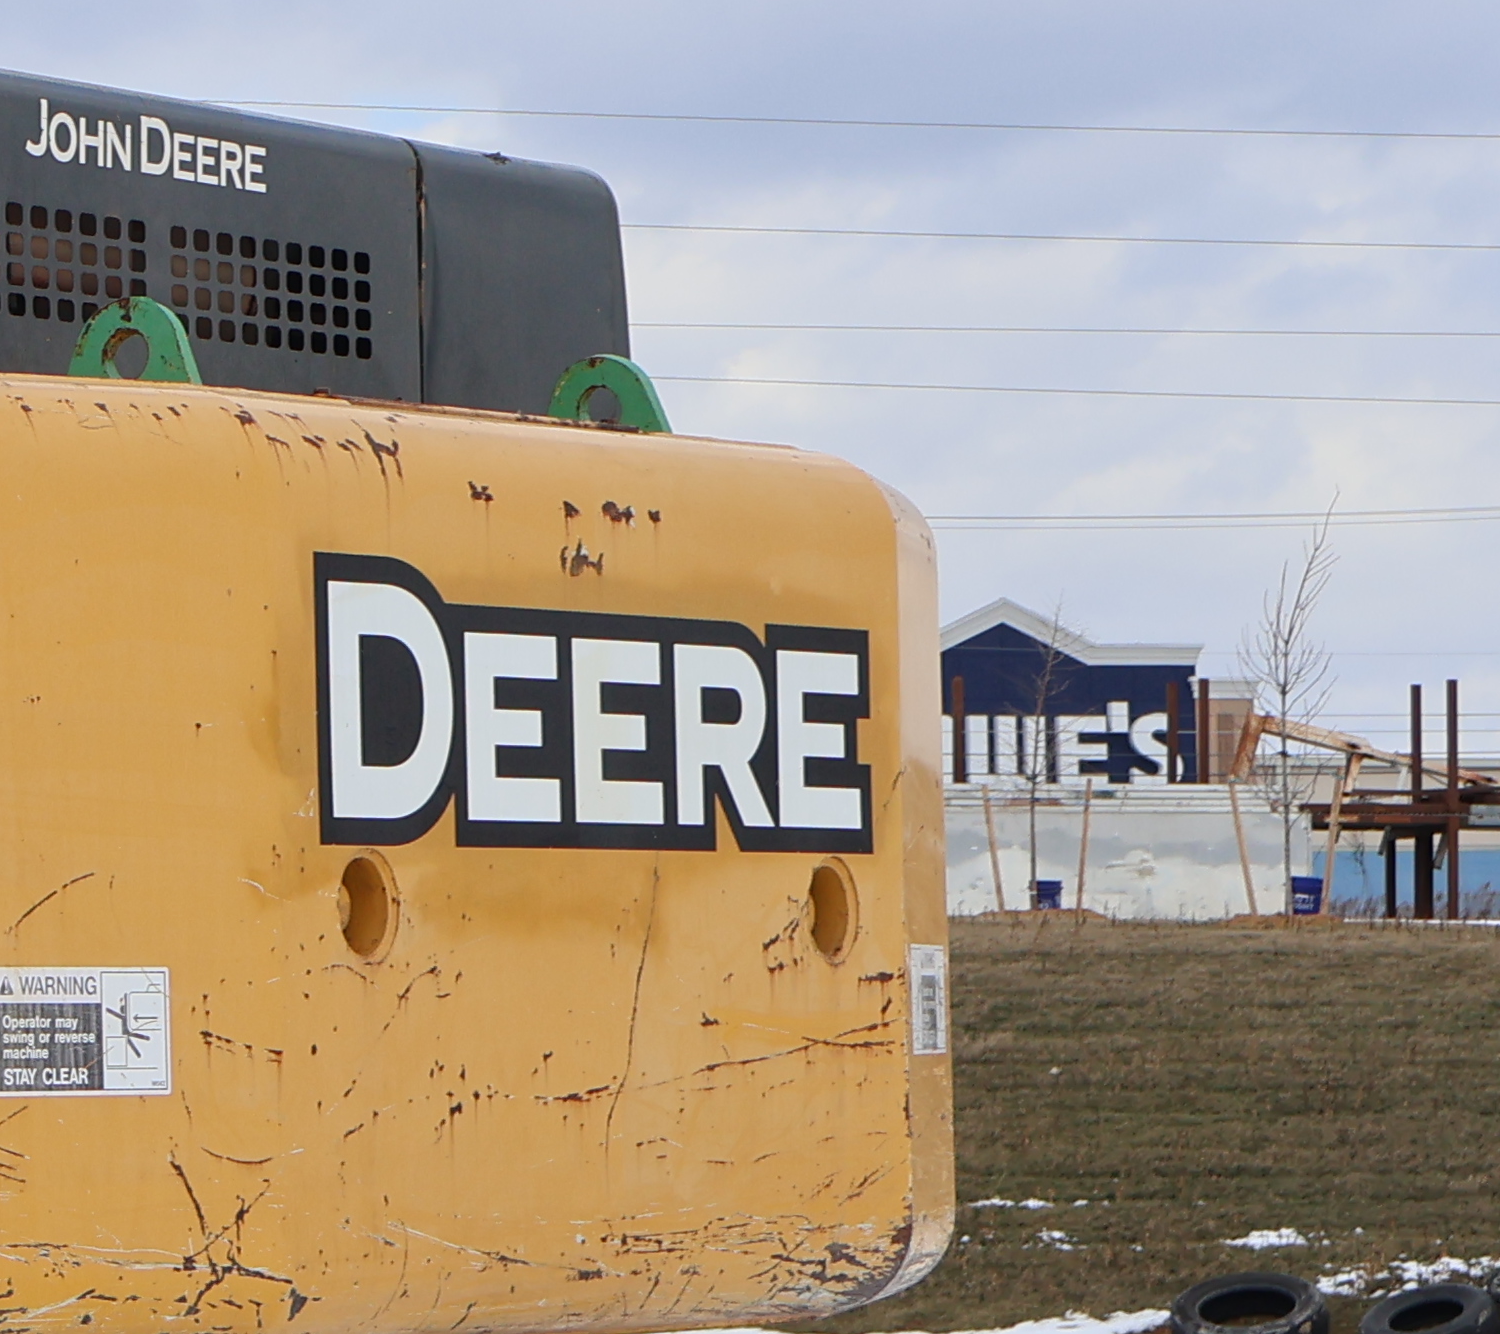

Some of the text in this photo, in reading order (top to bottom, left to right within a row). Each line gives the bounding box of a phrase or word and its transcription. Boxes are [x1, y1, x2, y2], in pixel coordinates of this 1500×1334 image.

[25, 98, 267, 194] JOHN DEERE
[326, 579, 863, 830] DEERE
[942, 700, 1185, 785] WE'S
[18, 975, 98, 995] WARNING
[2, 1015, 79, 1031] Operator may
[2, 1031, 96, 1046] swing or reverse
[2, 1046, 50, 1059] machine
[3, 1067, 90, 1085] STAY CLEAR
